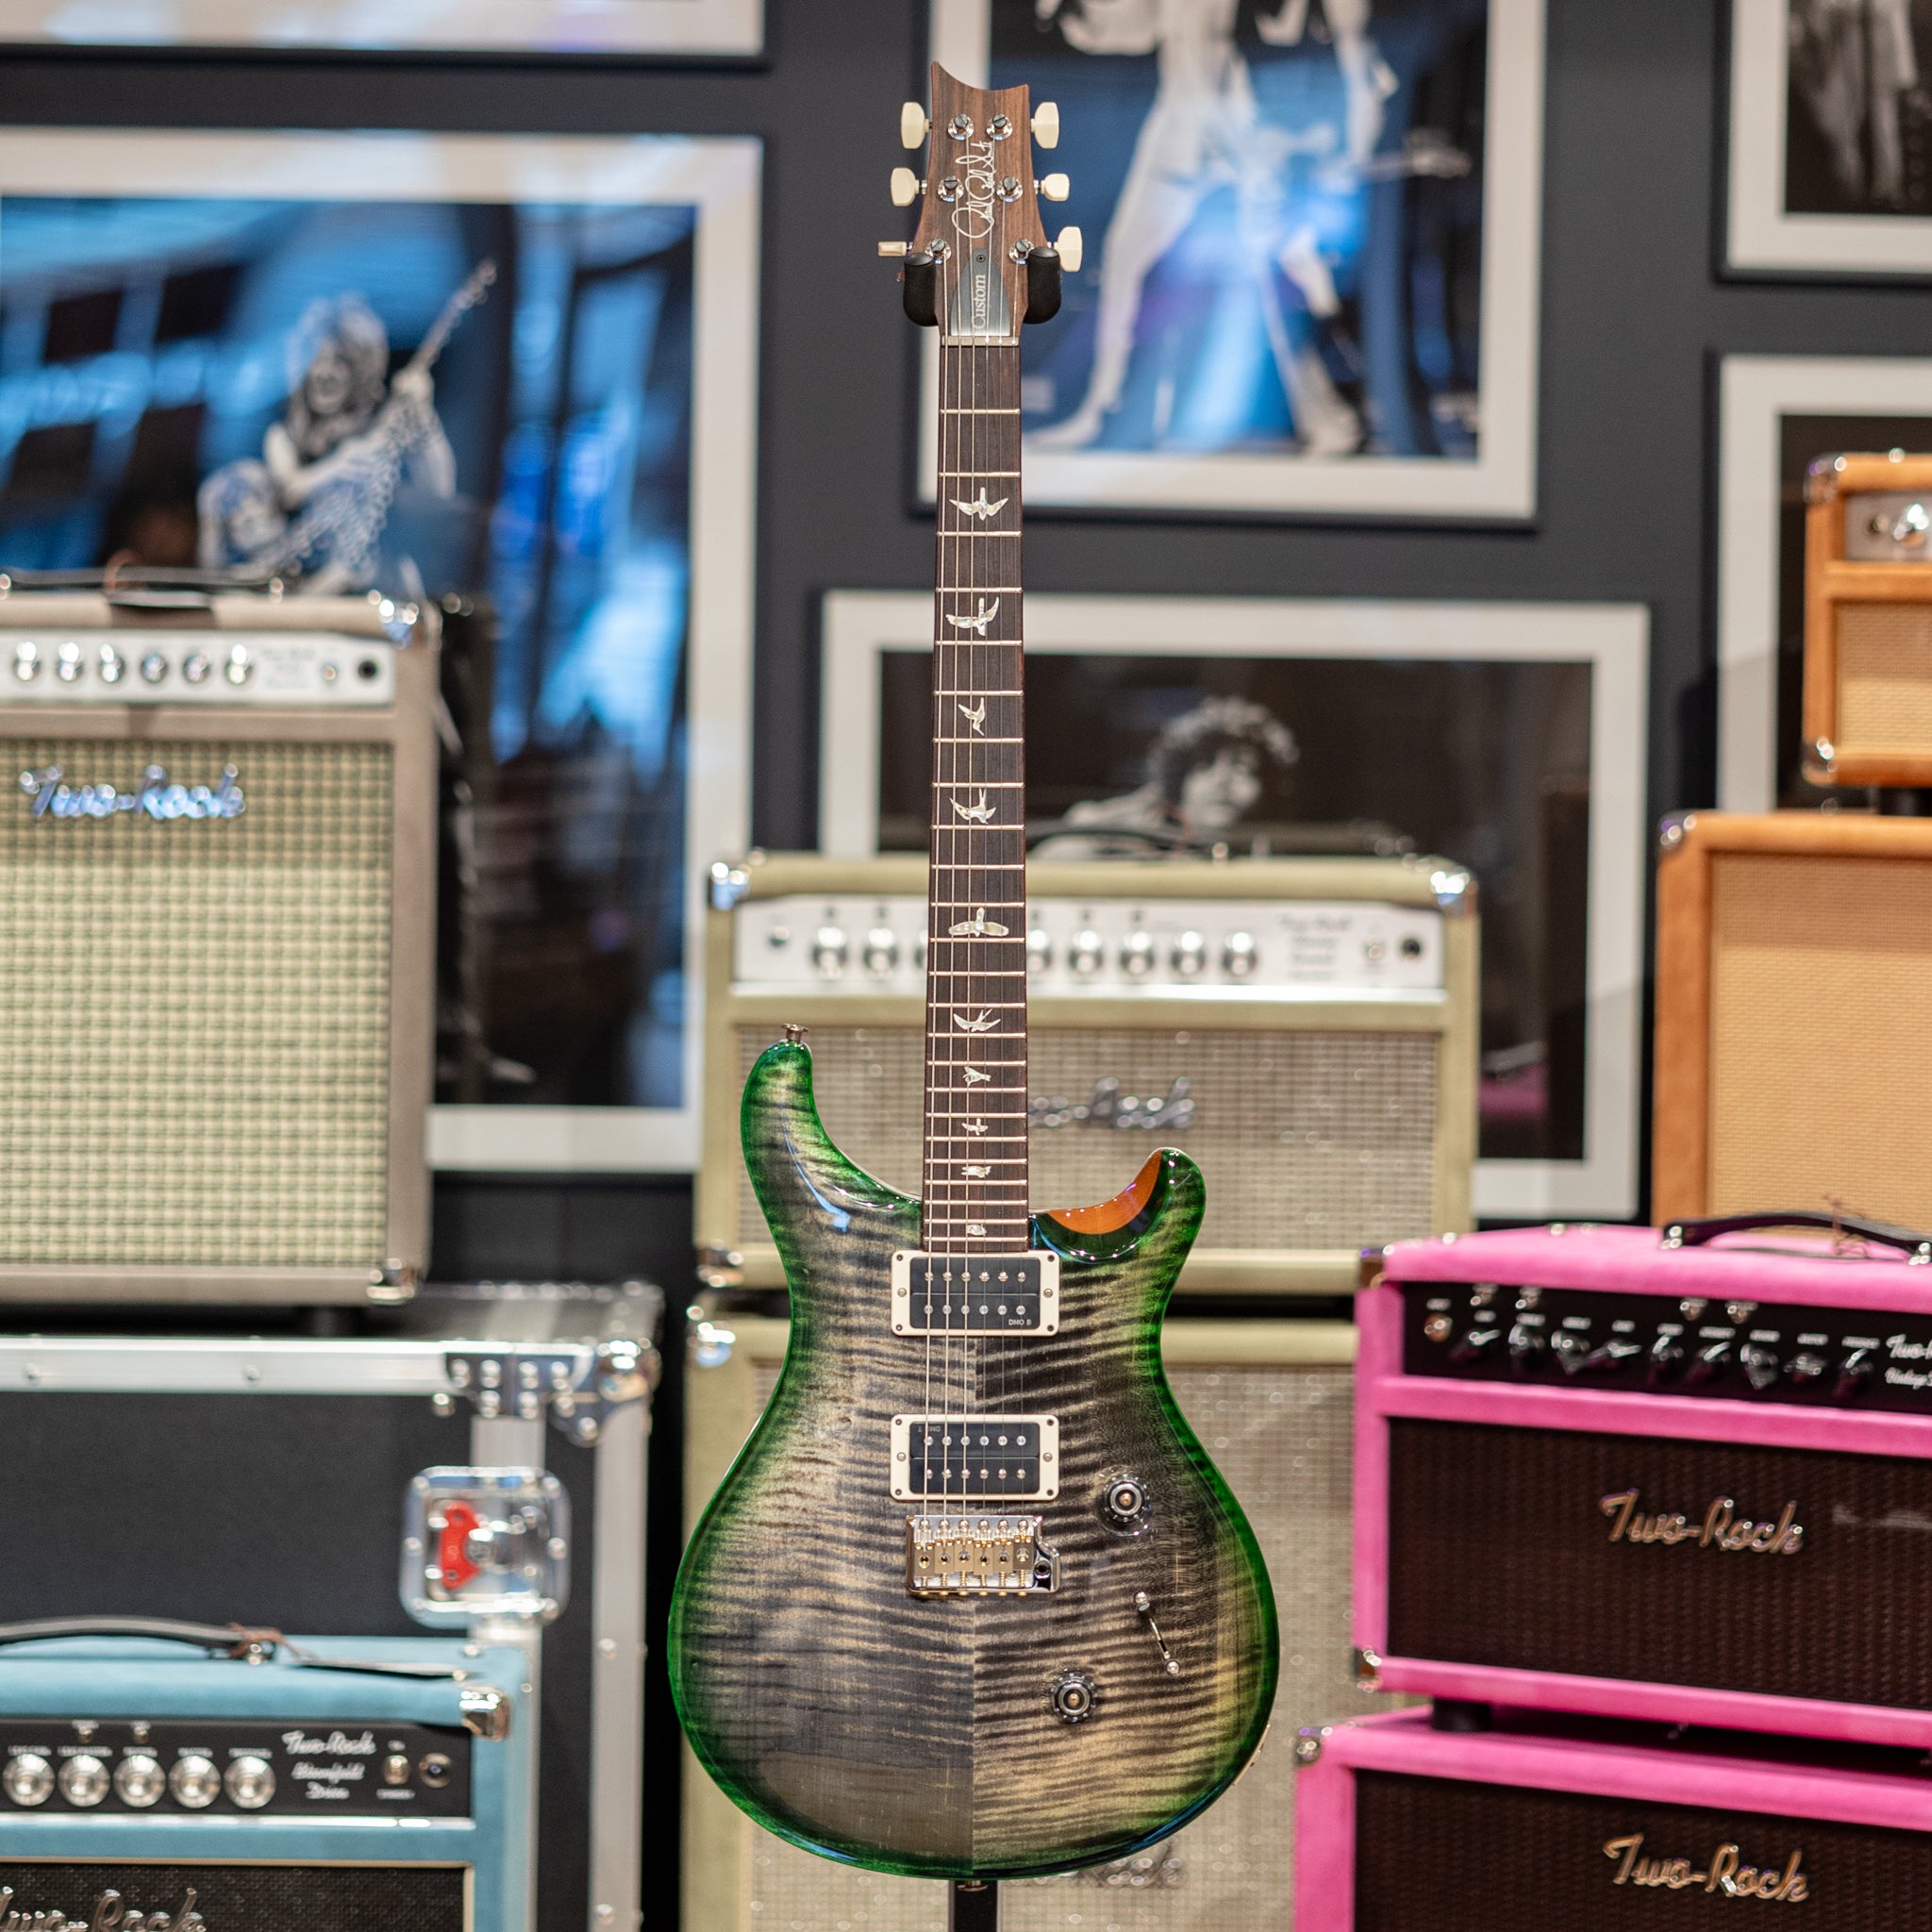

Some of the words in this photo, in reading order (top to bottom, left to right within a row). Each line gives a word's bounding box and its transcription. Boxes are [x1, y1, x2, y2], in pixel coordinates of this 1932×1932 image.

[971, 274, 986, 329] Custom
[1603, 1489, 1804, 1556] Two-Rock
[282, 1730, 376, 1755] Two-Rock
[1605, 1833, 1809, 1903] Two-Rock
